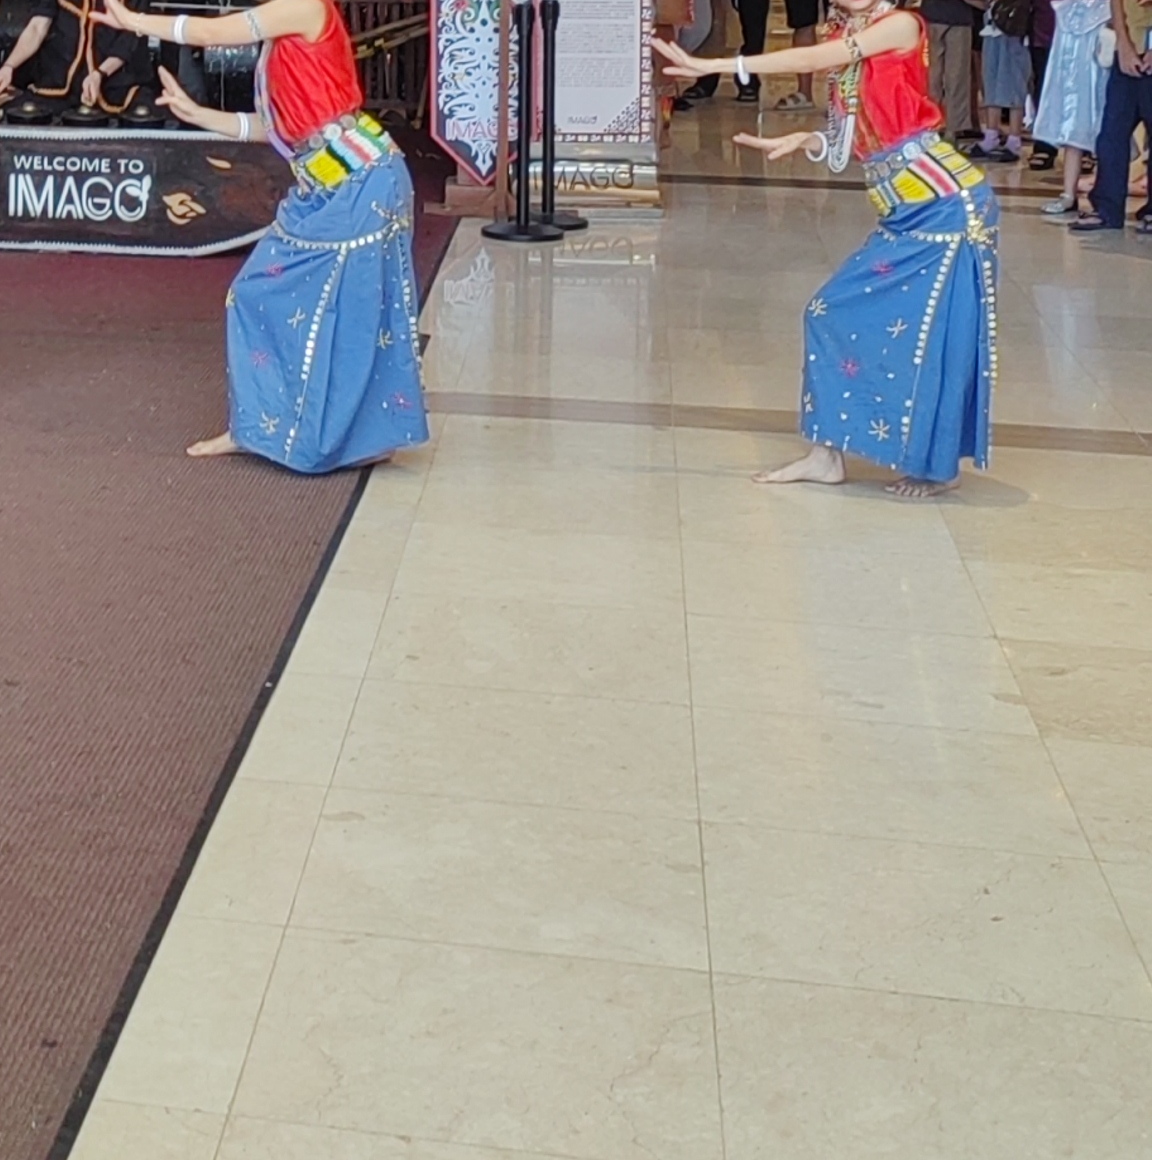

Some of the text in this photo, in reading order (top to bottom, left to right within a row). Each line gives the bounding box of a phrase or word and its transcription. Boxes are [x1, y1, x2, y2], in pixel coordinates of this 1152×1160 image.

[13, 155, 144, 174] WELCOME TO
[8, 172, 152, 222] IMAGO
